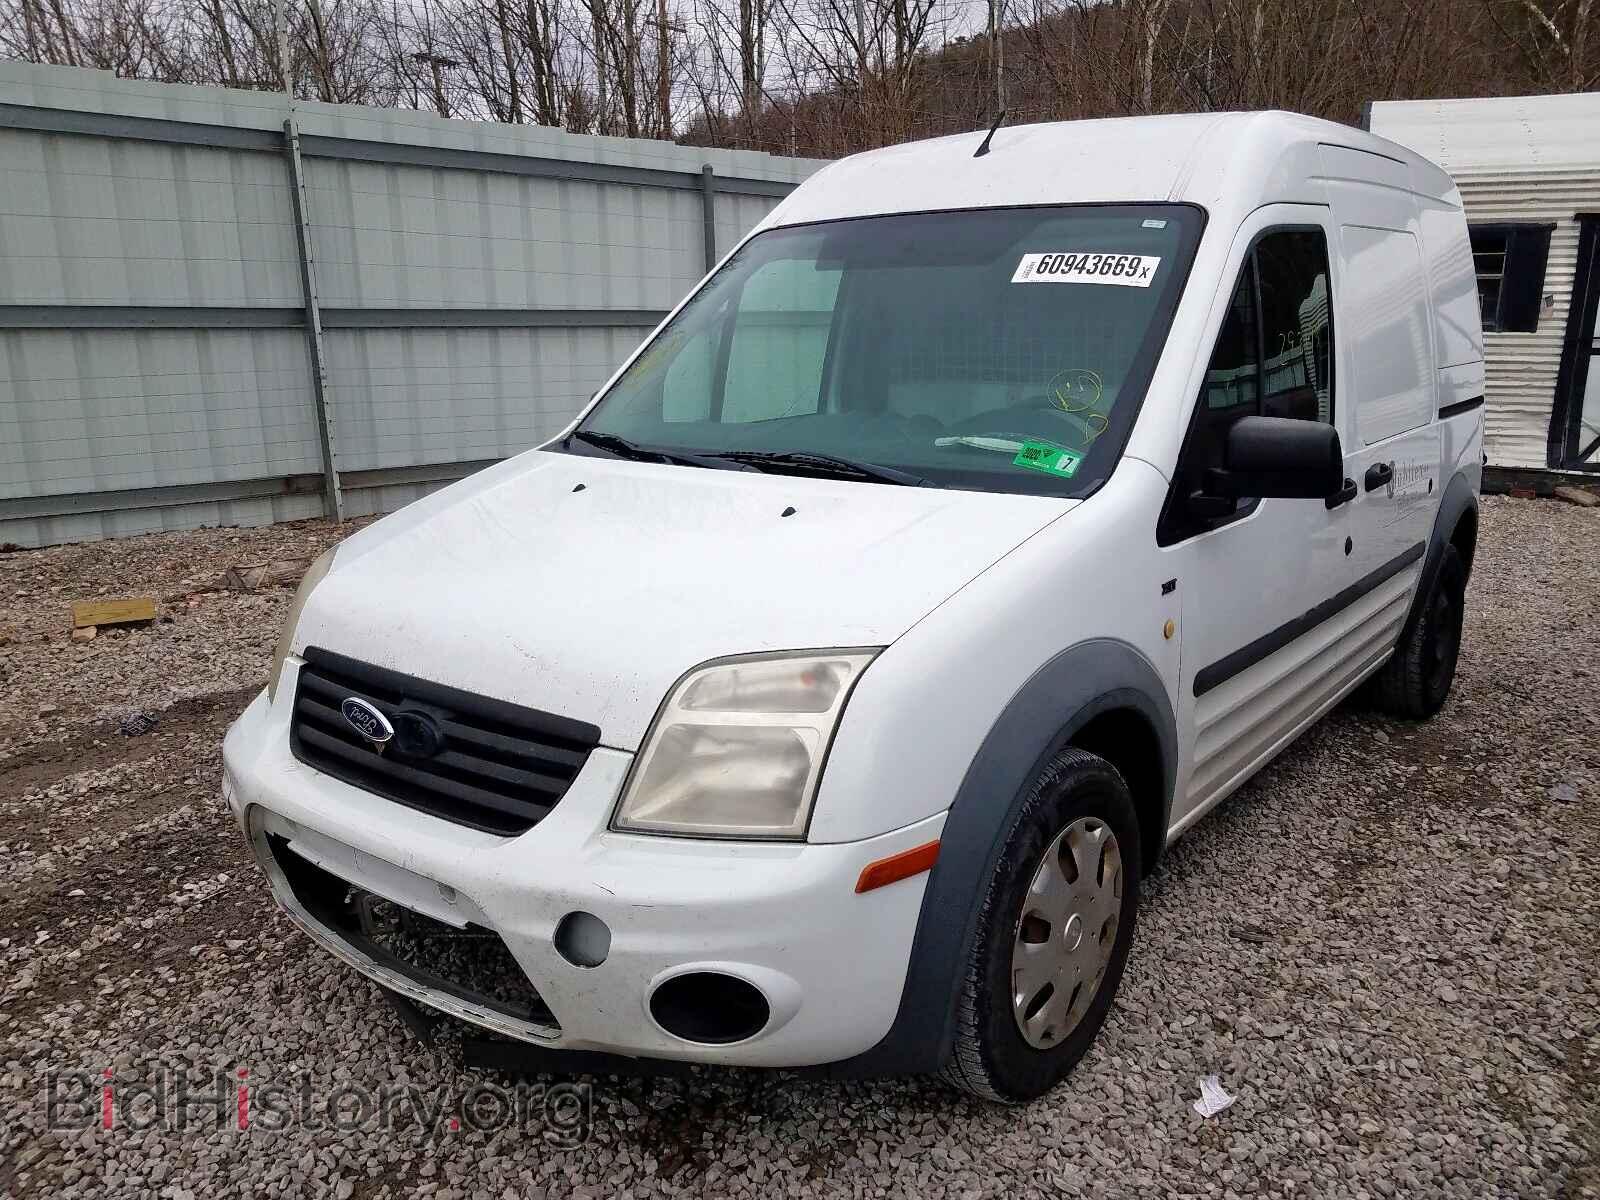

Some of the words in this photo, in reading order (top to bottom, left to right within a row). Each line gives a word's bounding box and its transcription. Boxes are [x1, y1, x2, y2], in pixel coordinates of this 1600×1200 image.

[1036, 254, 1142, 277] 60943669
[1022, 446, 1042, 461] 2020
[1063, 457, 1074, 470] 7
[350, 706, 377, 734] Ford
